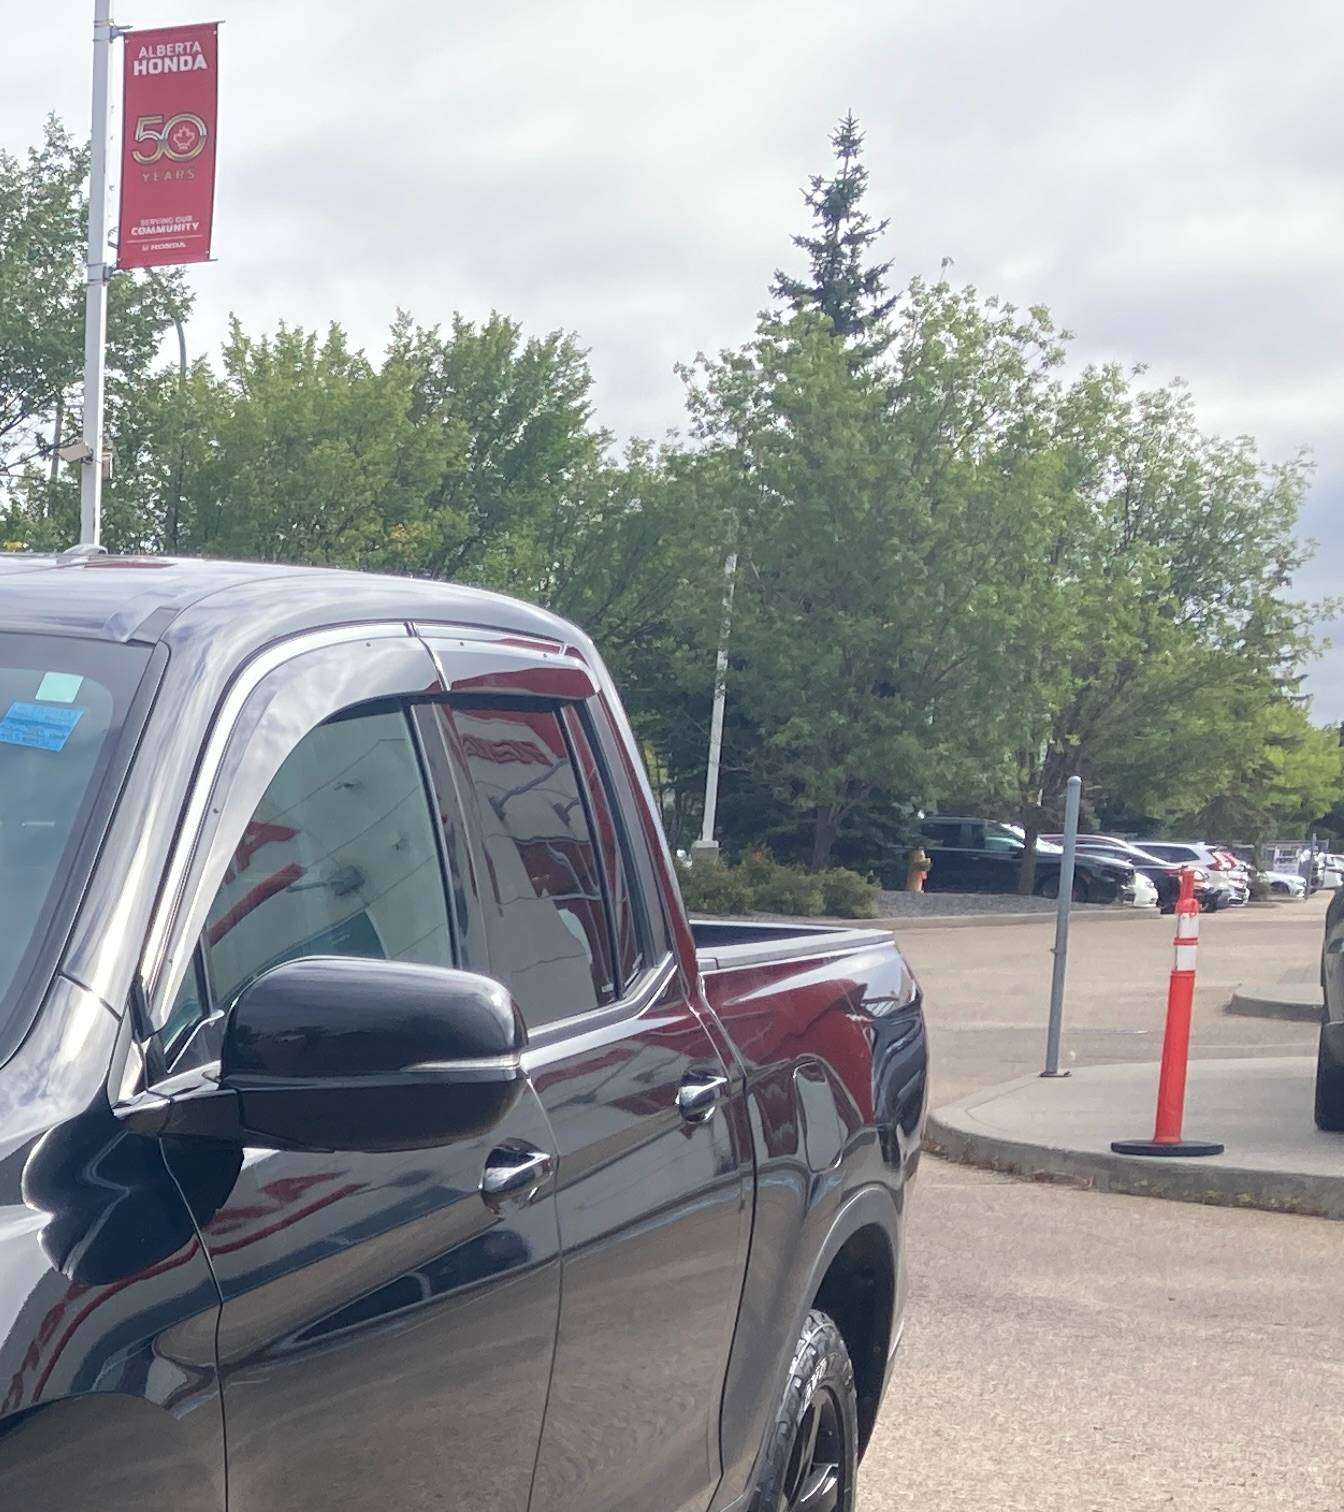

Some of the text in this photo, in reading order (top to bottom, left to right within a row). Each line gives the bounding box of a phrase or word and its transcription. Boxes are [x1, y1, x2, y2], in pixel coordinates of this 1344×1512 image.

[138, 41, 202, 59] ALBERTA
[133, 54, 208, 76] HONDA
[131, 113, 207, 165] 50
[130, 222, 199, 236] COMMUNITY
